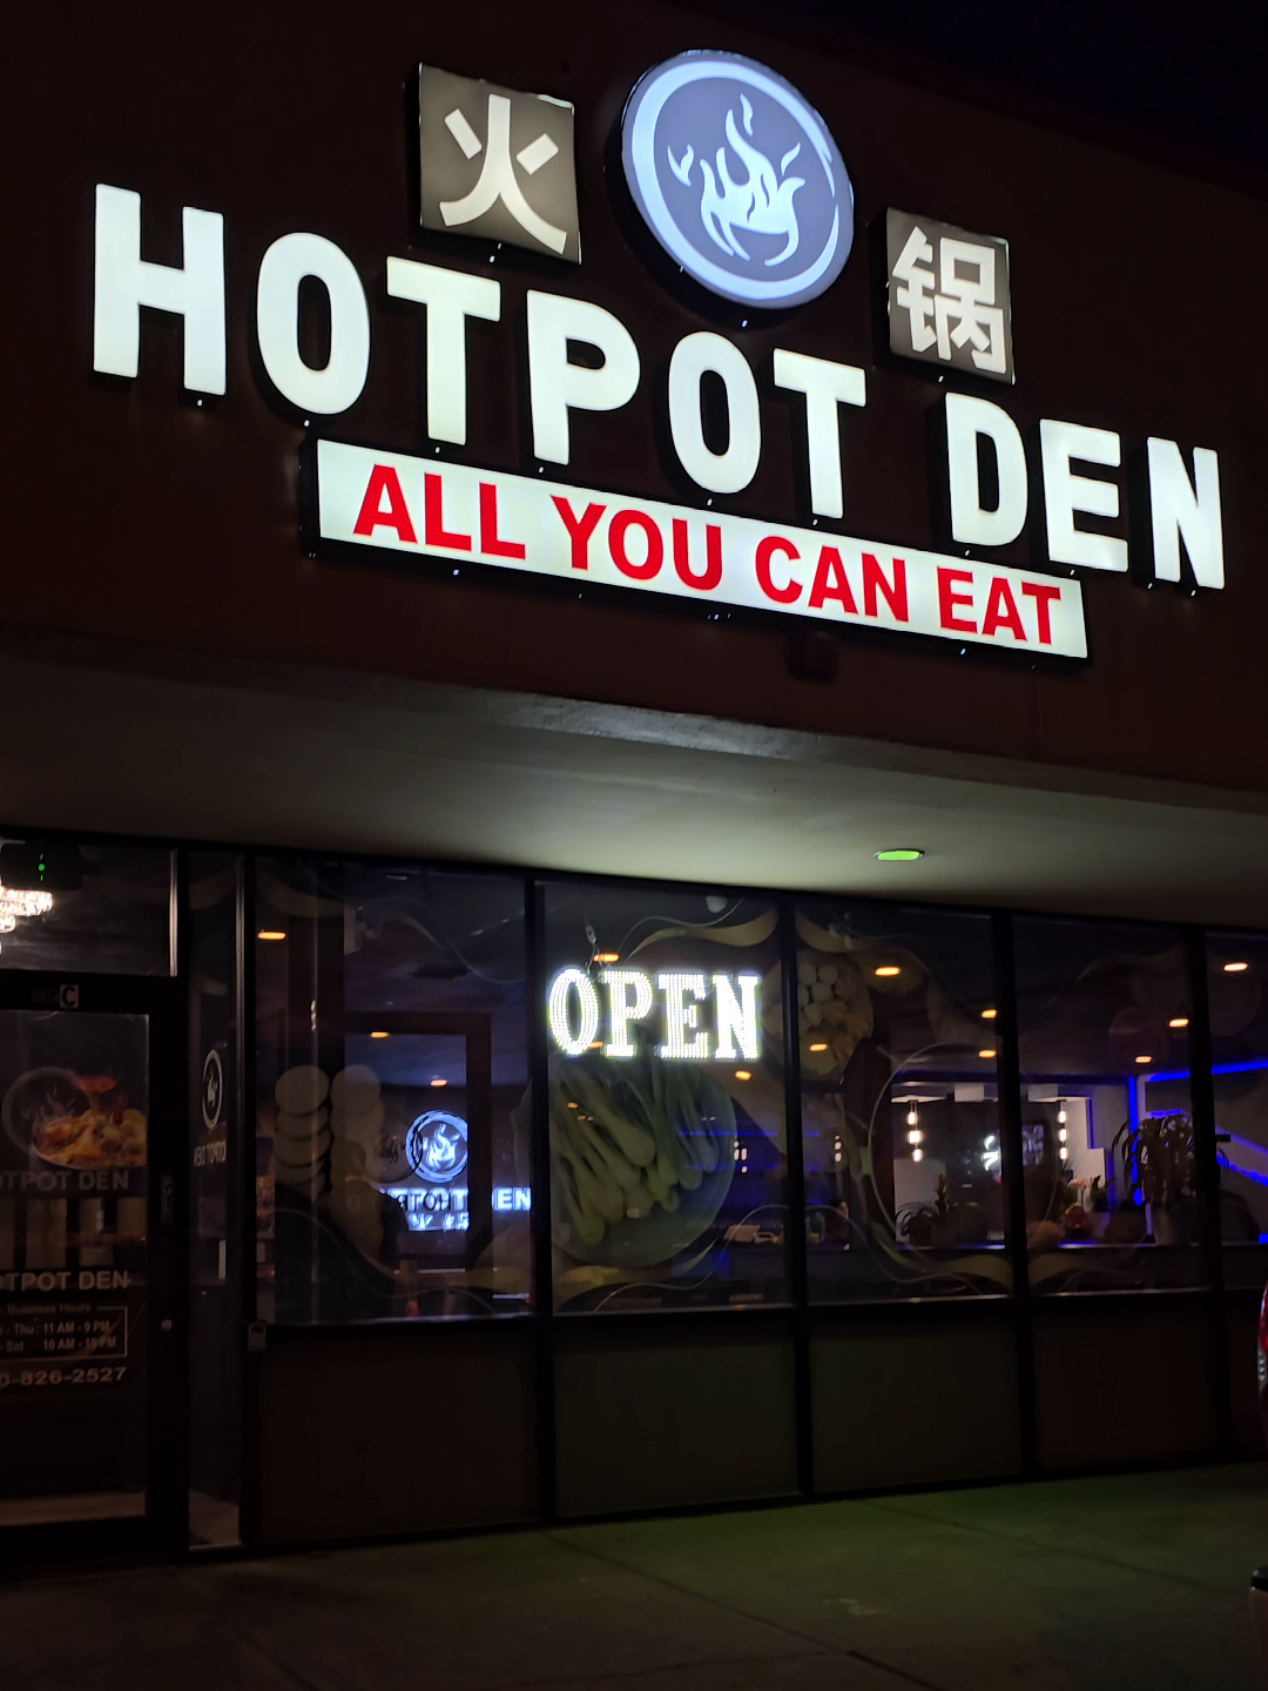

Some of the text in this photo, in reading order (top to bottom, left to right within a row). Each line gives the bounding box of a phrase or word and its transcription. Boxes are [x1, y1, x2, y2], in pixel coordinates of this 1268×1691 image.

[438, 94, 1007, 374] 火 锅
[94, 183, 1225, 589] HOTPOT DEN
[353, 464, 1060, 646] ALL YOU CAN EAT
[63, 986, 75, 1005] C
[546, 966, 762, 1062] OPEN
[79, 1169, 129, 1190] DEN
[79, 1269, 129, 1290] DEN
[59, 1303, 91, 1314] Hours
[43, 1321, 54, 1334] 11
[57, 1320, 75, 1333] AM
[93, 1319, 110, 1332] PM
[43, 1338, 55, 1352] 10
[57, 1337, 75, 1351] AM
[99, 1335, 117, 1349] PM
